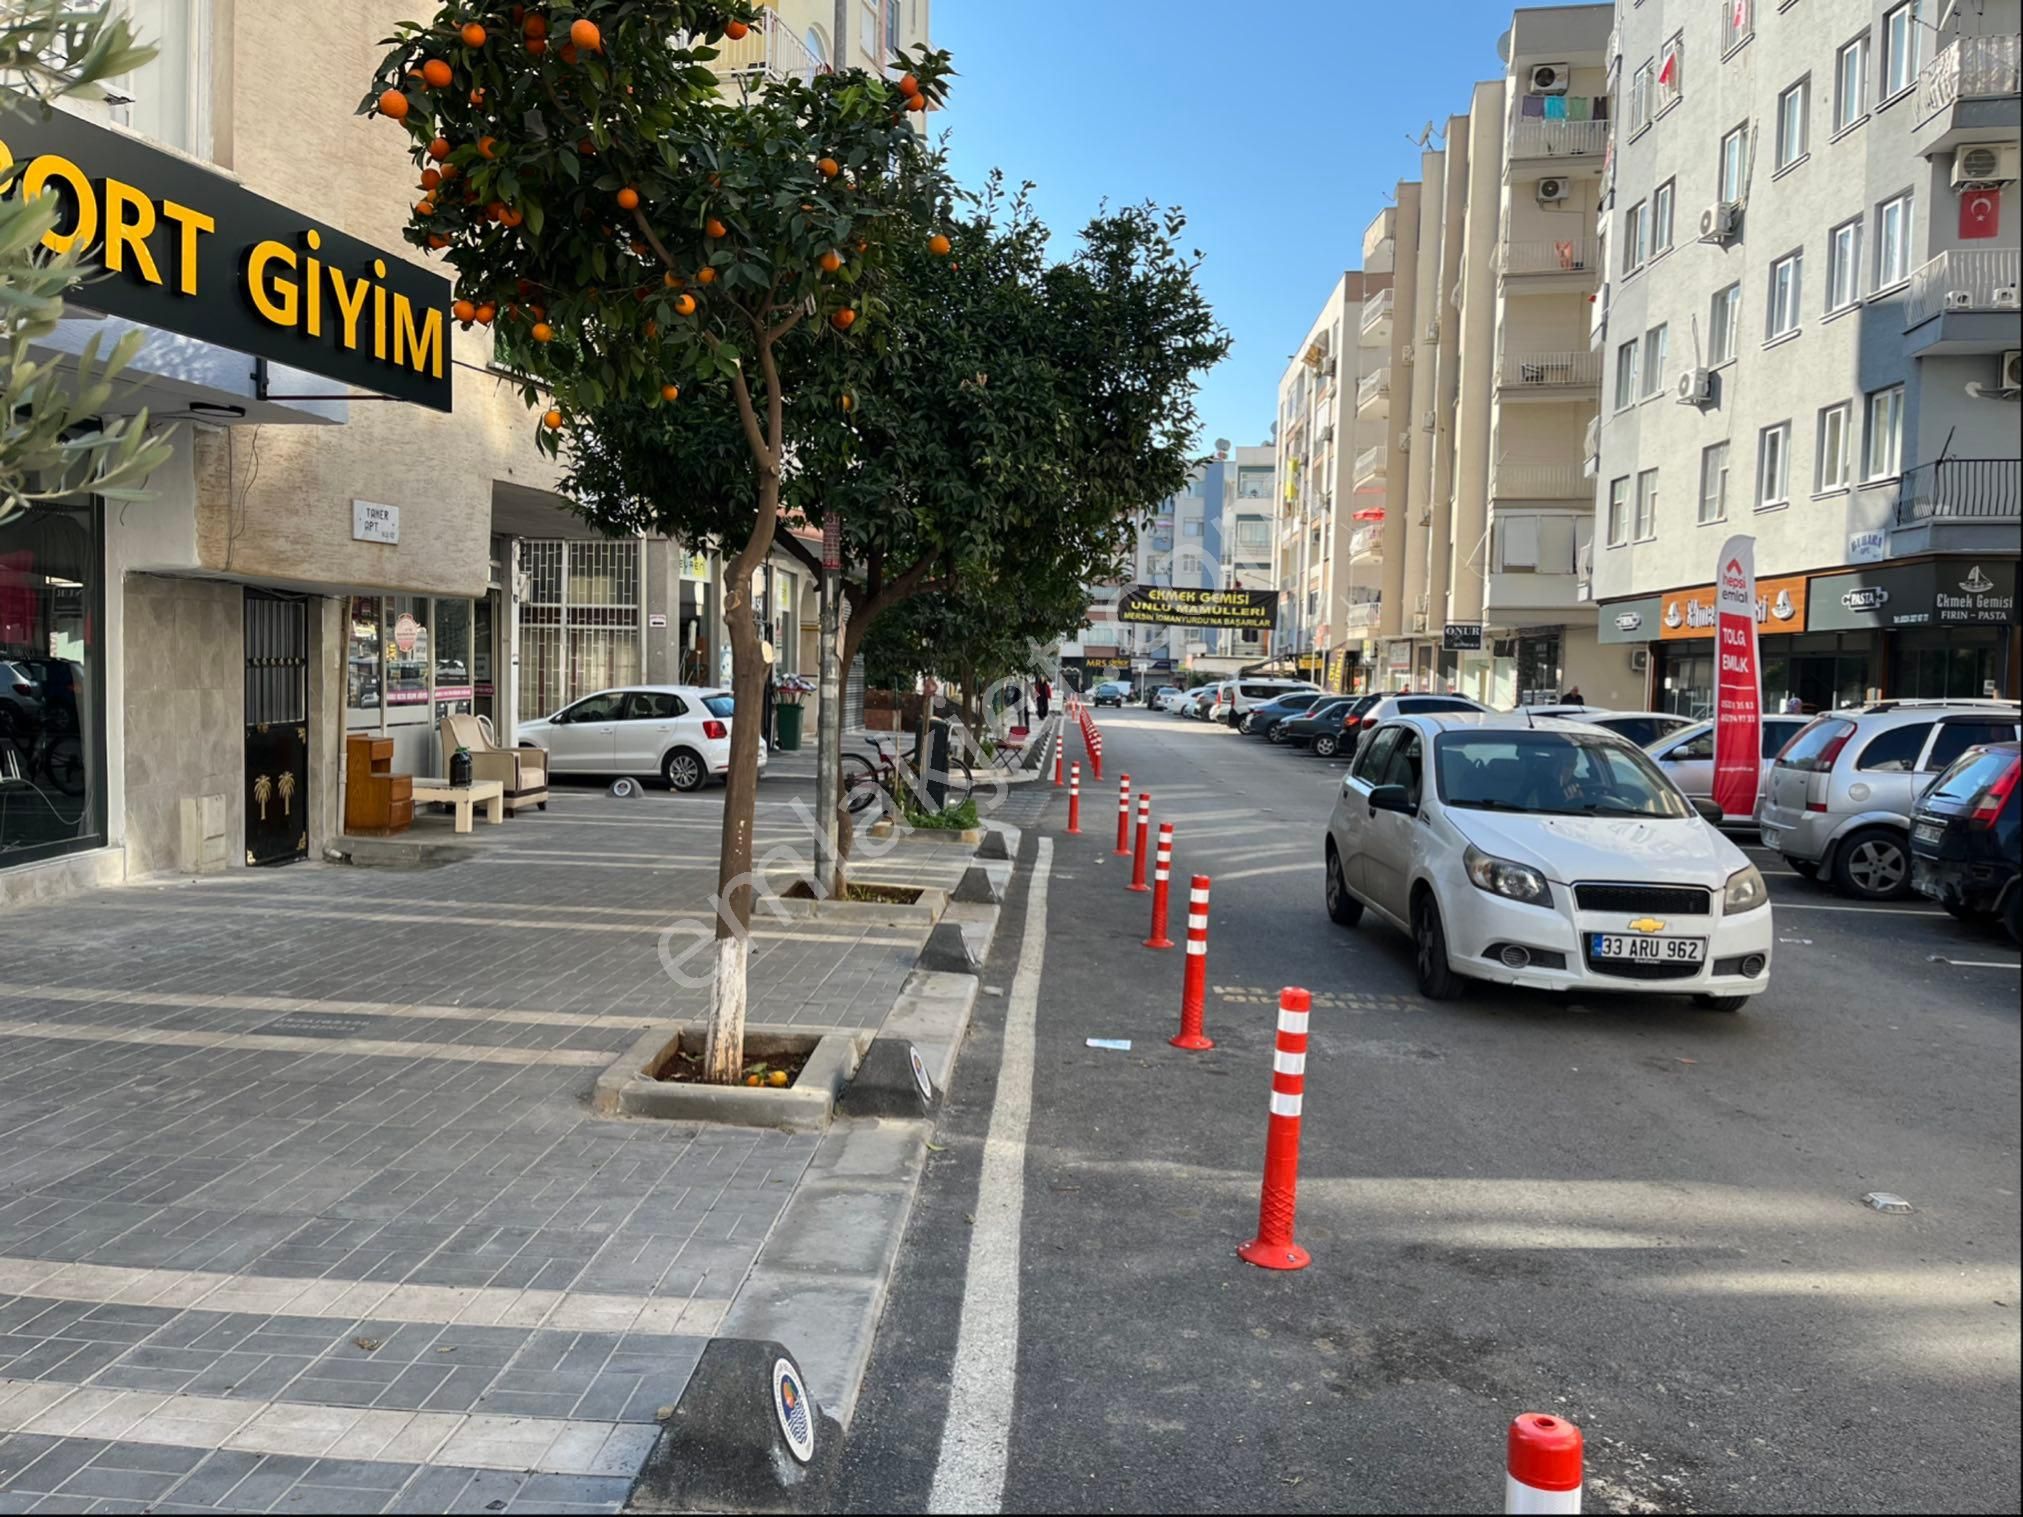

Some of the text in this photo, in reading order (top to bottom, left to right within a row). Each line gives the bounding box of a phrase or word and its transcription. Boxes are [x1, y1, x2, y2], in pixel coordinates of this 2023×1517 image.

[0, 139, 443, 379] ORT GİYİM
[1723, 575, 1747, 589] hepsi
[1148, 589, 1250, 605] EKMEK GEMİSİ
[1851, 592, 1875, 606] PASTA
[1936, 593, 2013, 609] Ekmek Gemisi
[1941, 610, 1968, 620] FIRIN
[1978, 611, 2008, 621] PASTA
[1446, 626, 1480, 636] ONUR
[1603, 938, 1698, 959] 33 ARU 962
